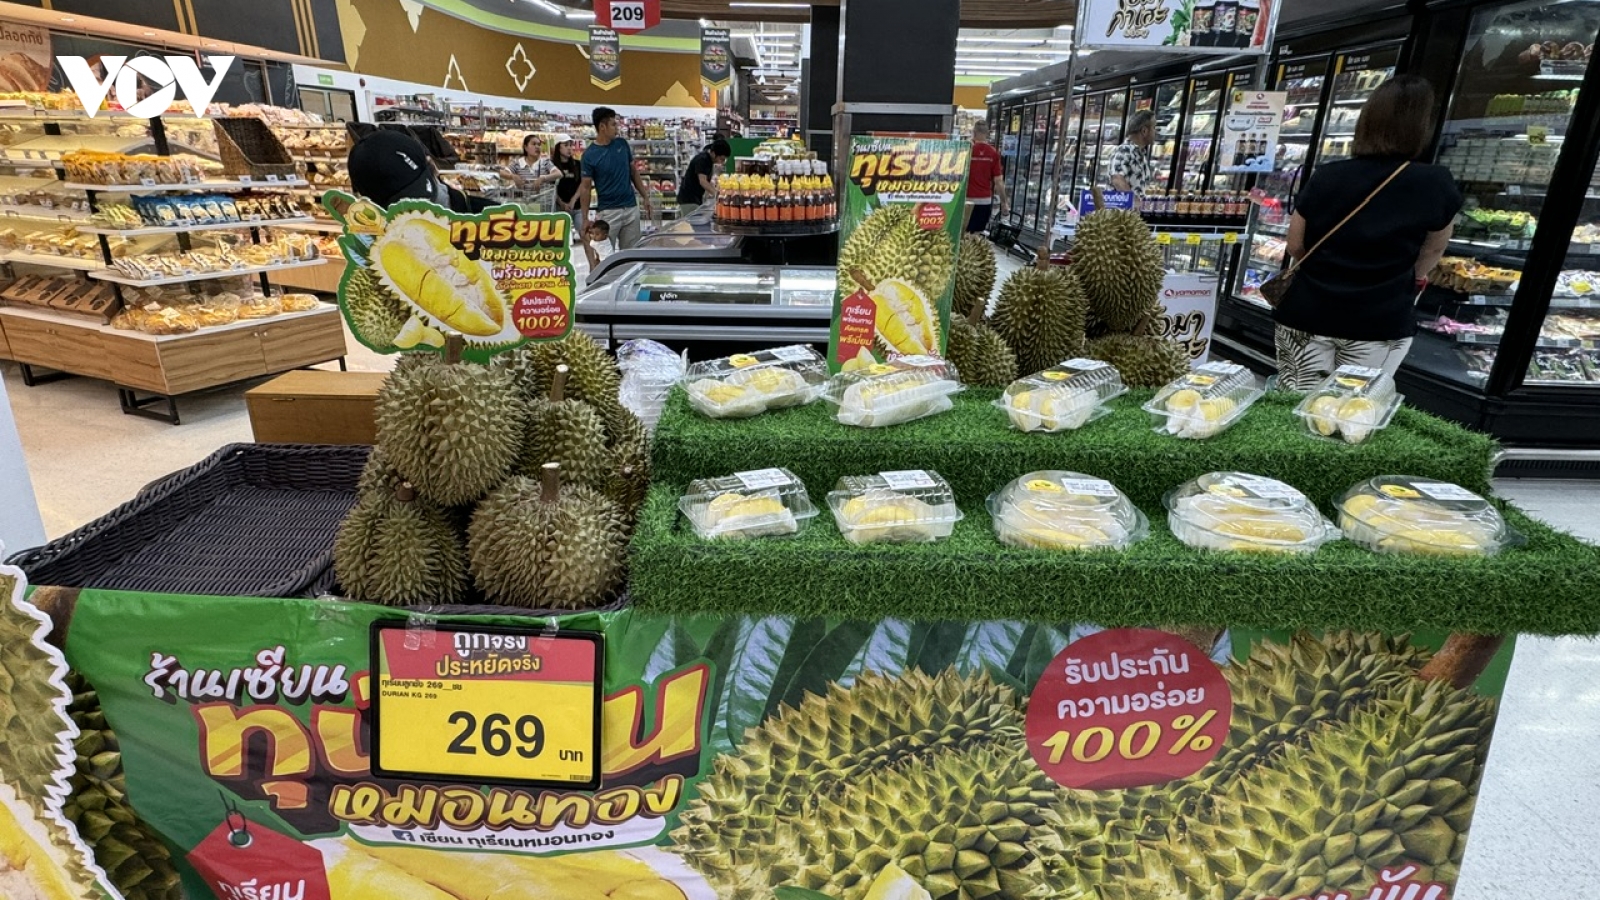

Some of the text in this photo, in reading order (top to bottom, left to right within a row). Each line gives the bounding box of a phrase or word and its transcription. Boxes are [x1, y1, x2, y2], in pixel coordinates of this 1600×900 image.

[611, 6, 644, 21] 209
[850, 142, 968, 188] ทุเรียน
[876, 180, 960, 192] หมอนทอง
[919, 215, 945, 225] 100%
[451, 210, 566, 254] ทุเรียน
[481, 249, 565, 261] หมอนทอง
[492, 264, 569, 279] พร้อมทาน
[520, 305, 561, 315] ความอร่อย
[522, 295, 556, 306] รับประกัน
[845, 304, 872, 316] ทุเรียน
[518, 315, 566, 329] 100%
[453, 632, 526, 657] ถูกจรง
[144, 645, 349, 699] ร้านเซียน
[435, 653, 541, 677] ประหยัดจริง
[1064, 647, 1190, 685] รับประกัน
[1056, 680, 1205, 720] ความอร่อย
[446, 710, 584, 762] 269 บาท
[1041, 709, 1218, 764] 100%
[331, 778, 681, 827] หมอนทอง
[419, 829, 615, 848] เซียน ทุเรียนหมอนทอง
